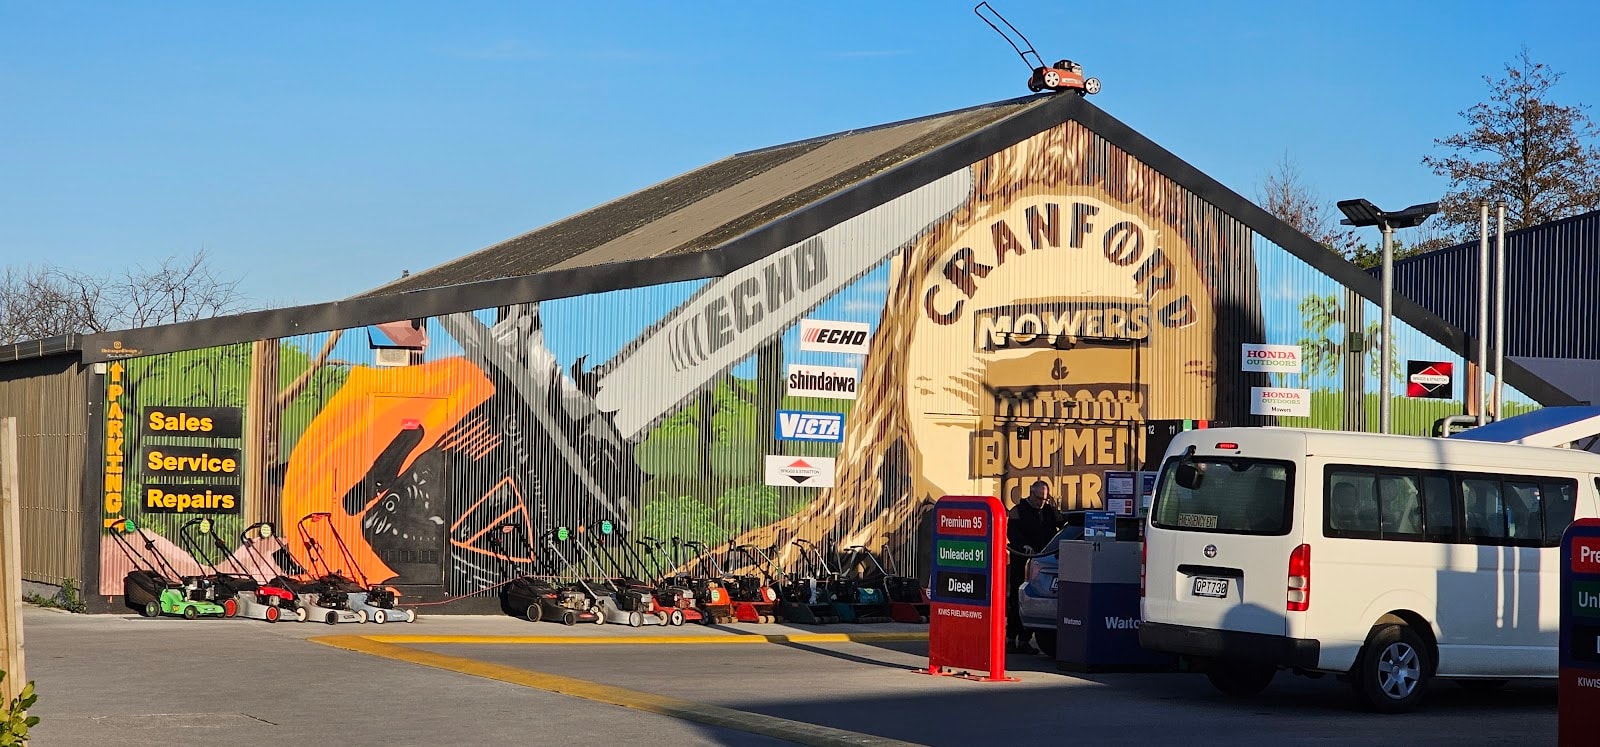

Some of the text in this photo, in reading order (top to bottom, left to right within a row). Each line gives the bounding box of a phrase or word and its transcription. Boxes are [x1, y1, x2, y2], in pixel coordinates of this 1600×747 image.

[923, 202, 1199, 329] CRANFORD
[705, 235, 829, 355] ECHO
[816, 328, 867, 346] ECHO
[978, 306, 1149, 349] MOWERS
[1246, 359, 1297, 367] OUTDOORS
[1247, 350, 1297, 359] HONDA
[1051, 357, 1069, 381] &
[789, 370, 856, 393] shindaiwa
[1262, 391, 1300, 399] HONDA
[149, 411, 213, 432] Sales
[779, 412, 841, 438] VICTA
[1147, 424, 1176, 435] 12 11
[105, 383, 124, 514] PARKING
[981, 425, 1147, 476] EQUIPMEN
[147, 451, 237, 473] Service
[147, 488, 235, 513] Repairs
[1004, 472, 1104, 512] CENTR
[941, 514, 983, 529] Premium 95
[939, 547, 984, 562] Unleaded 91
[1092, 542, 1101, 552] 11
[1580, 545, 1600, 563] Pre
[948, 577, 974, 594] Diesel
[1104, 616, 1141, 630] Waito
